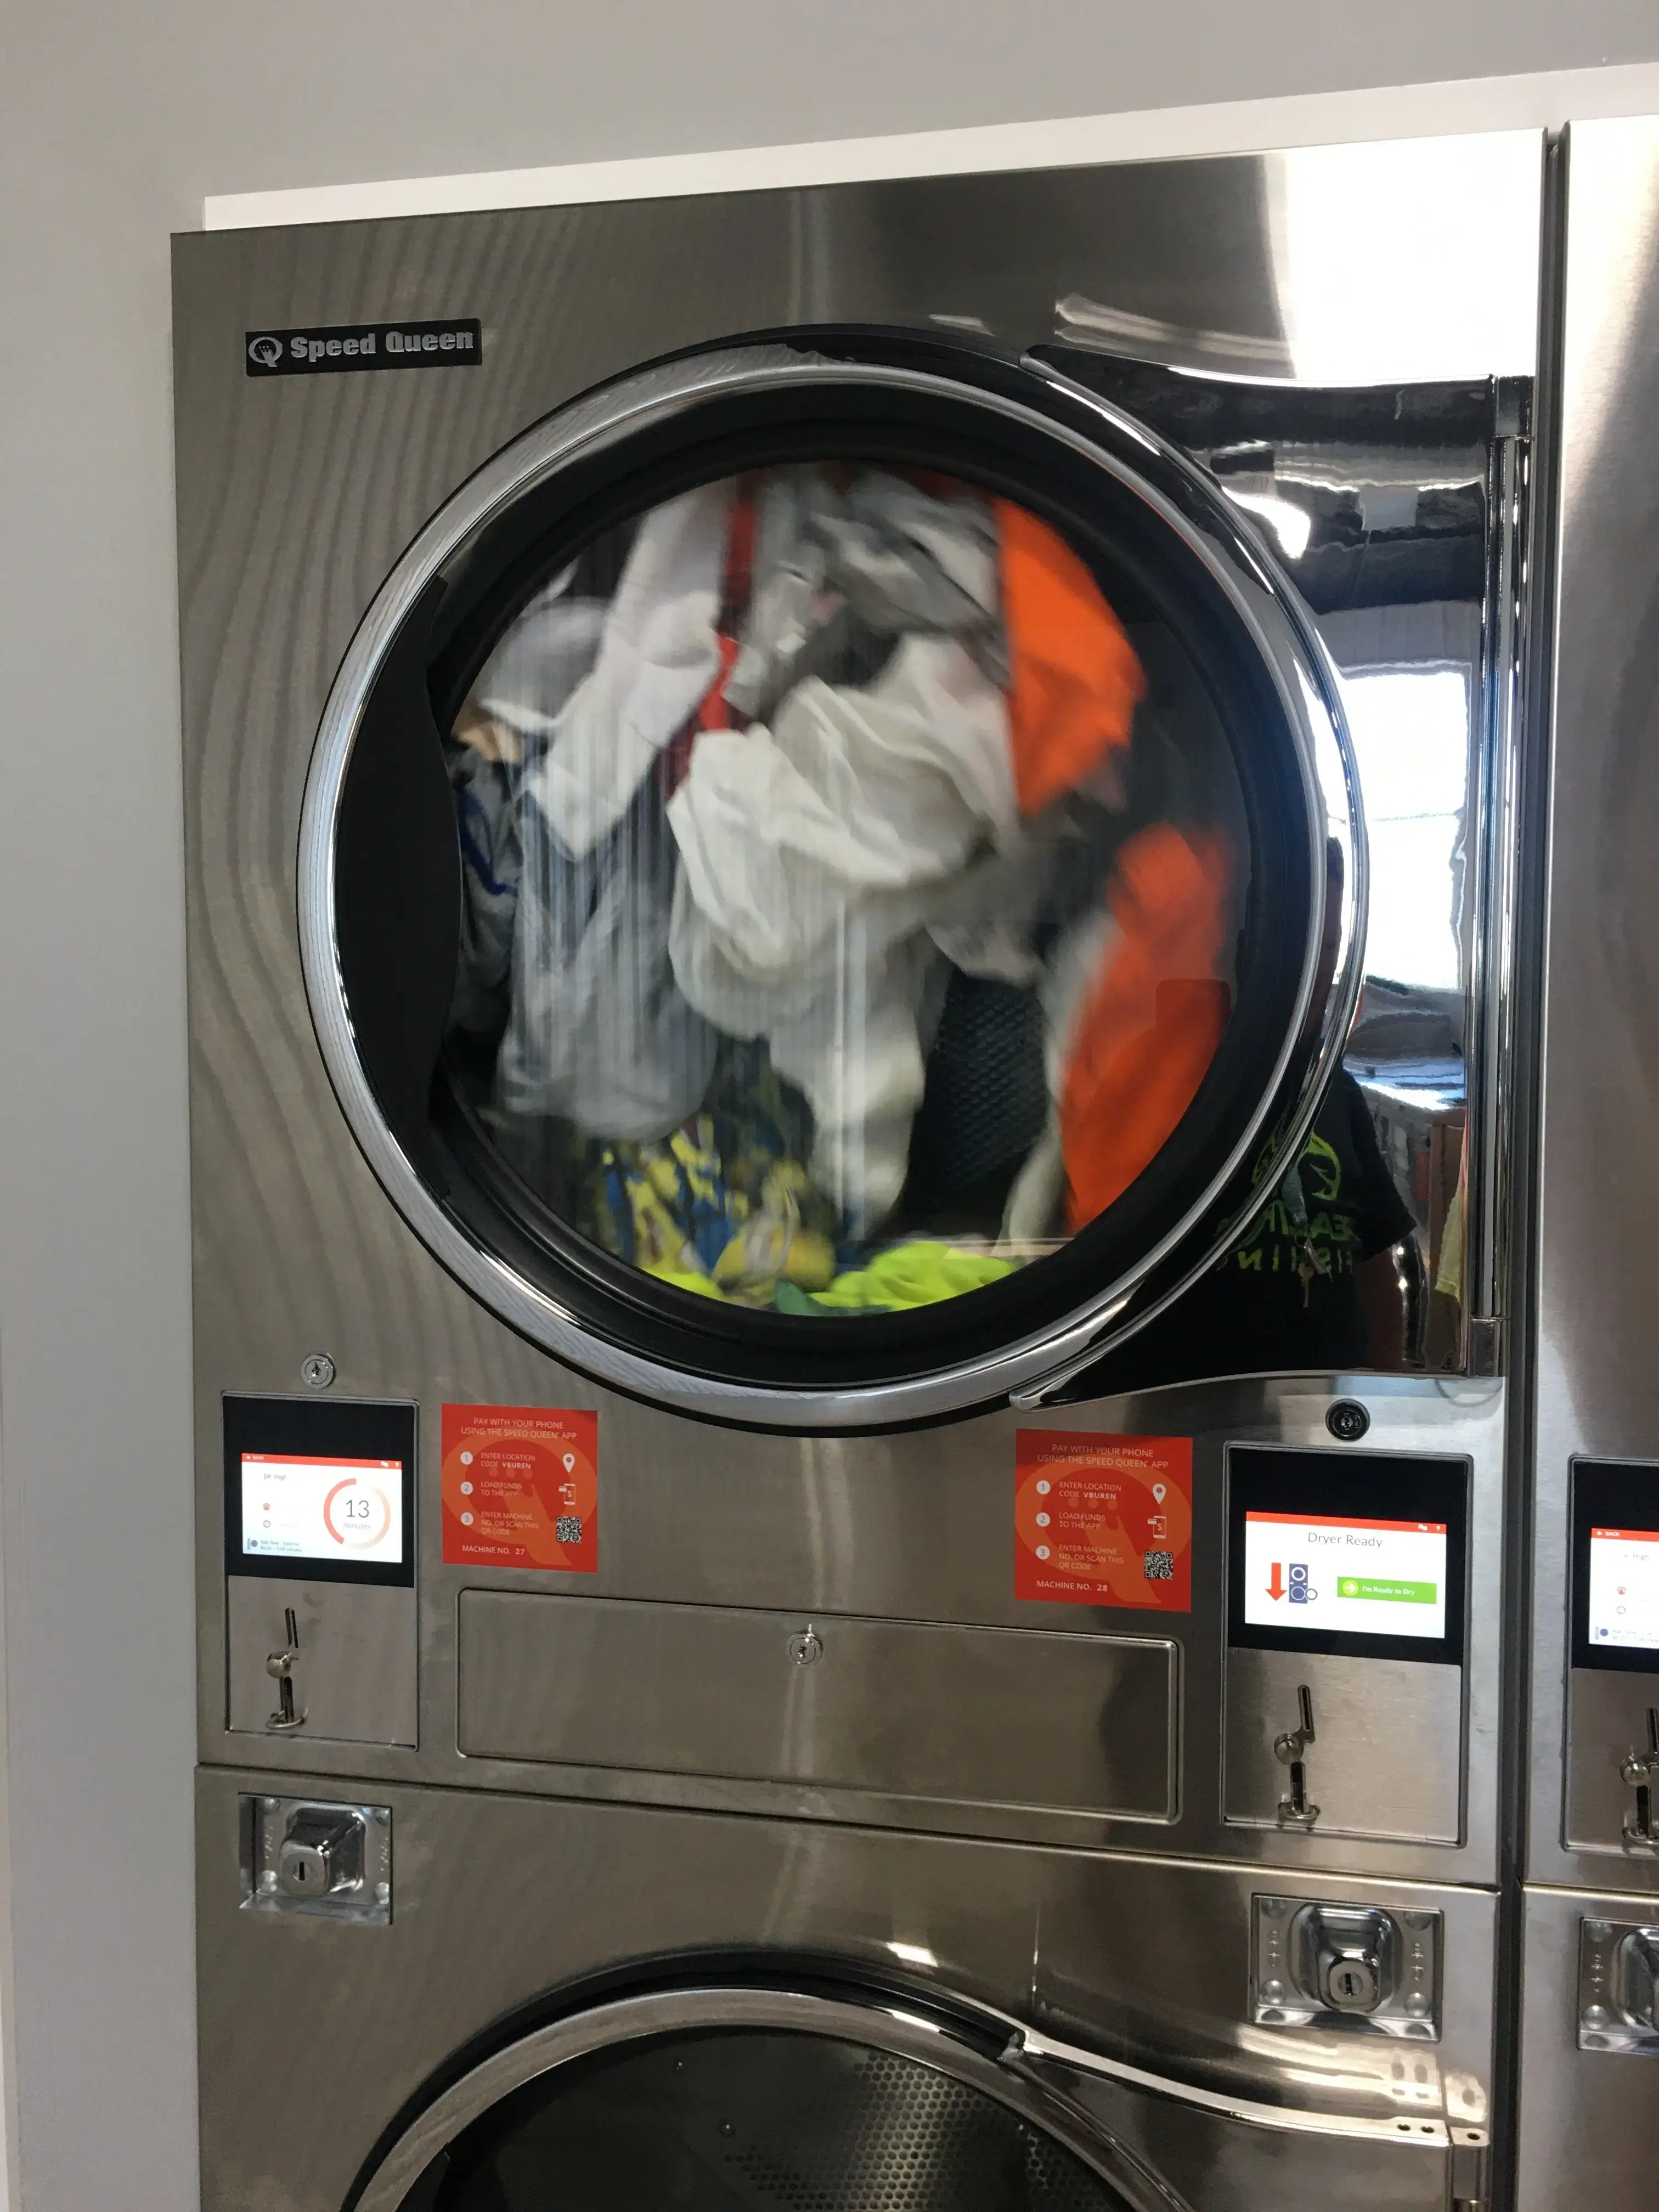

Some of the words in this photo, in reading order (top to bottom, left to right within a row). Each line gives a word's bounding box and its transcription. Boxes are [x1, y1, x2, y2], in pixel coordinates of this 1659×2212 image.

[291, 333, 376, 362] Speed
[386, 331, 473, 352] Queen
[473, 1417, 488, 1425] PAY
[490, 1418, 510, 1426] WITH
[512, 1419, 534, 1427] YOUR
[536, 1420, 564, 1429] PHONE
[461, 1427, 486, 1435] USING
[504, 1429, 528, 1437] SPEED
[1070, 1445, 1093, 1454] WITH
[1095, 1446, 1120, 1455] YOUR
[1122, 1448, 1154, 1458] PHONE
[503, 1453, 535, 1462] LOCATION
[1037, 1454, 1065, 1463] USING
[1067, 1455, 1084, 1464] THE
[1086, 1457, 1114, 1466] SPEED
[1151, 1460, 1169, 1469] APP
[1084, 1482, 1121, 1492] LOCATION
[1083, 1491, 1116, 1500] VBUREN
[346, 1499, 370, 1519] 13
[503, 1512, 533, 1521] MACHINE
[1080, 1513, 1105, 1521] FUNDS
[1308, 1532, 1342, 1545] Dryer
[1346, 1534, 1383, 1549] Ready
[462, 1545, 496, 1554] MACHINE
[498, 1547, 511, 1555] NO.
[515, 1548, 525, 1556] 27
[1059, 1544, 1082, 1553] ENTER
[1084, 1545, 1118, 1555] MACHINE
[1086, 1555, 1106, 1563] SCAN
[1059, 1562, 1070, 1570] QR
[1071, 1562, 1092, 1571] CODE
[1036, 1579, 1074, 1589] MACHINE
[1076, 1582, 1092, 1591] NO.
[1373, 1587, 1393, 1595] Ready
